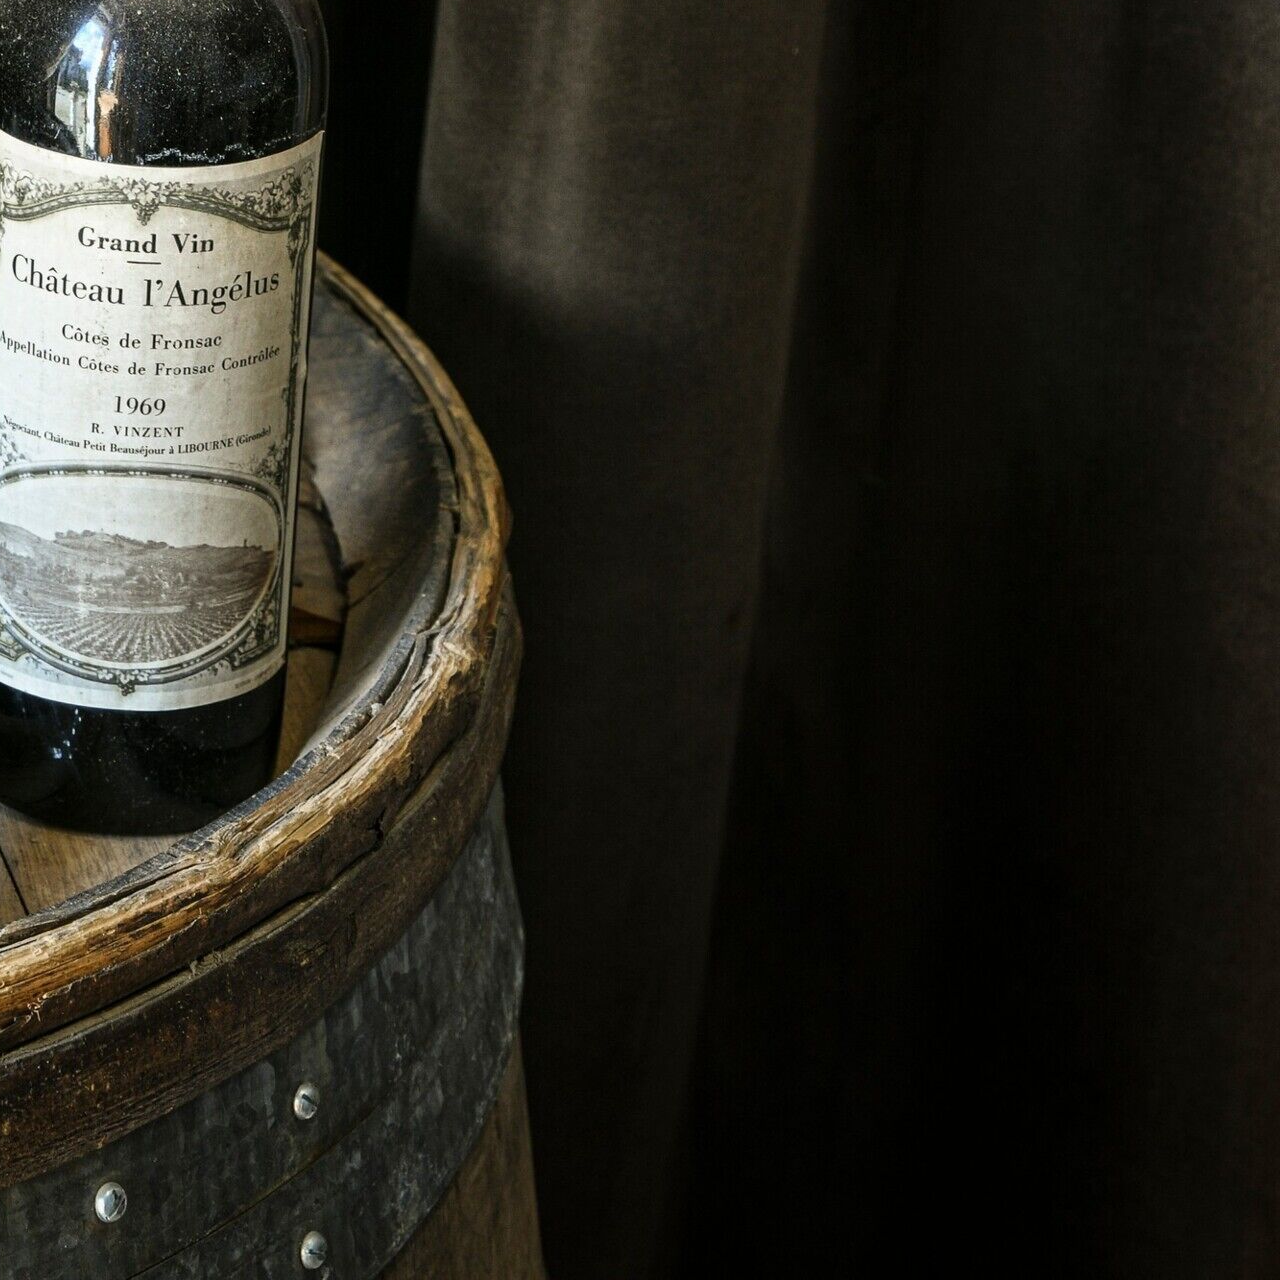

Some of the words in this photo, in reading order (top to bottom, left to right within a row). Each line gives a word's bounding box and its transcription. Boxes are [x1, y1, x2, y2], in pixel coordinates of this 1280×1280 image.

[78, 225, 158, 255] Grand
[172, 233, 215, 255] Vin
[11, 253, 126, 306] Château
[142, 270, 281, 315] l'Angélus
[61, 323, 111, 347] Côtes
[119, 332, 142, 350] de
[150, 333, 223, 351] Fronsac
[0, 329, 71, 367] Appellation
[77, 354, 120, 375] Côtes
[127, 361, 147, 376] de
[154, 361, 216, 377] Fronsac
[220, 345, 281, 371] Contrôlée
[114, 395, 167, 418] 1969
[43, 430, 81, 449] Château
[82, 438, 107, 453] Petit
[109, 442, 166, 458] Beauséjour
[168, 444, 176, 456] à
[177, 437, 235, 455] LIBOURNE
[90, 422, 105, 436] R.
[113, 424, 185, 439] VINZENT
